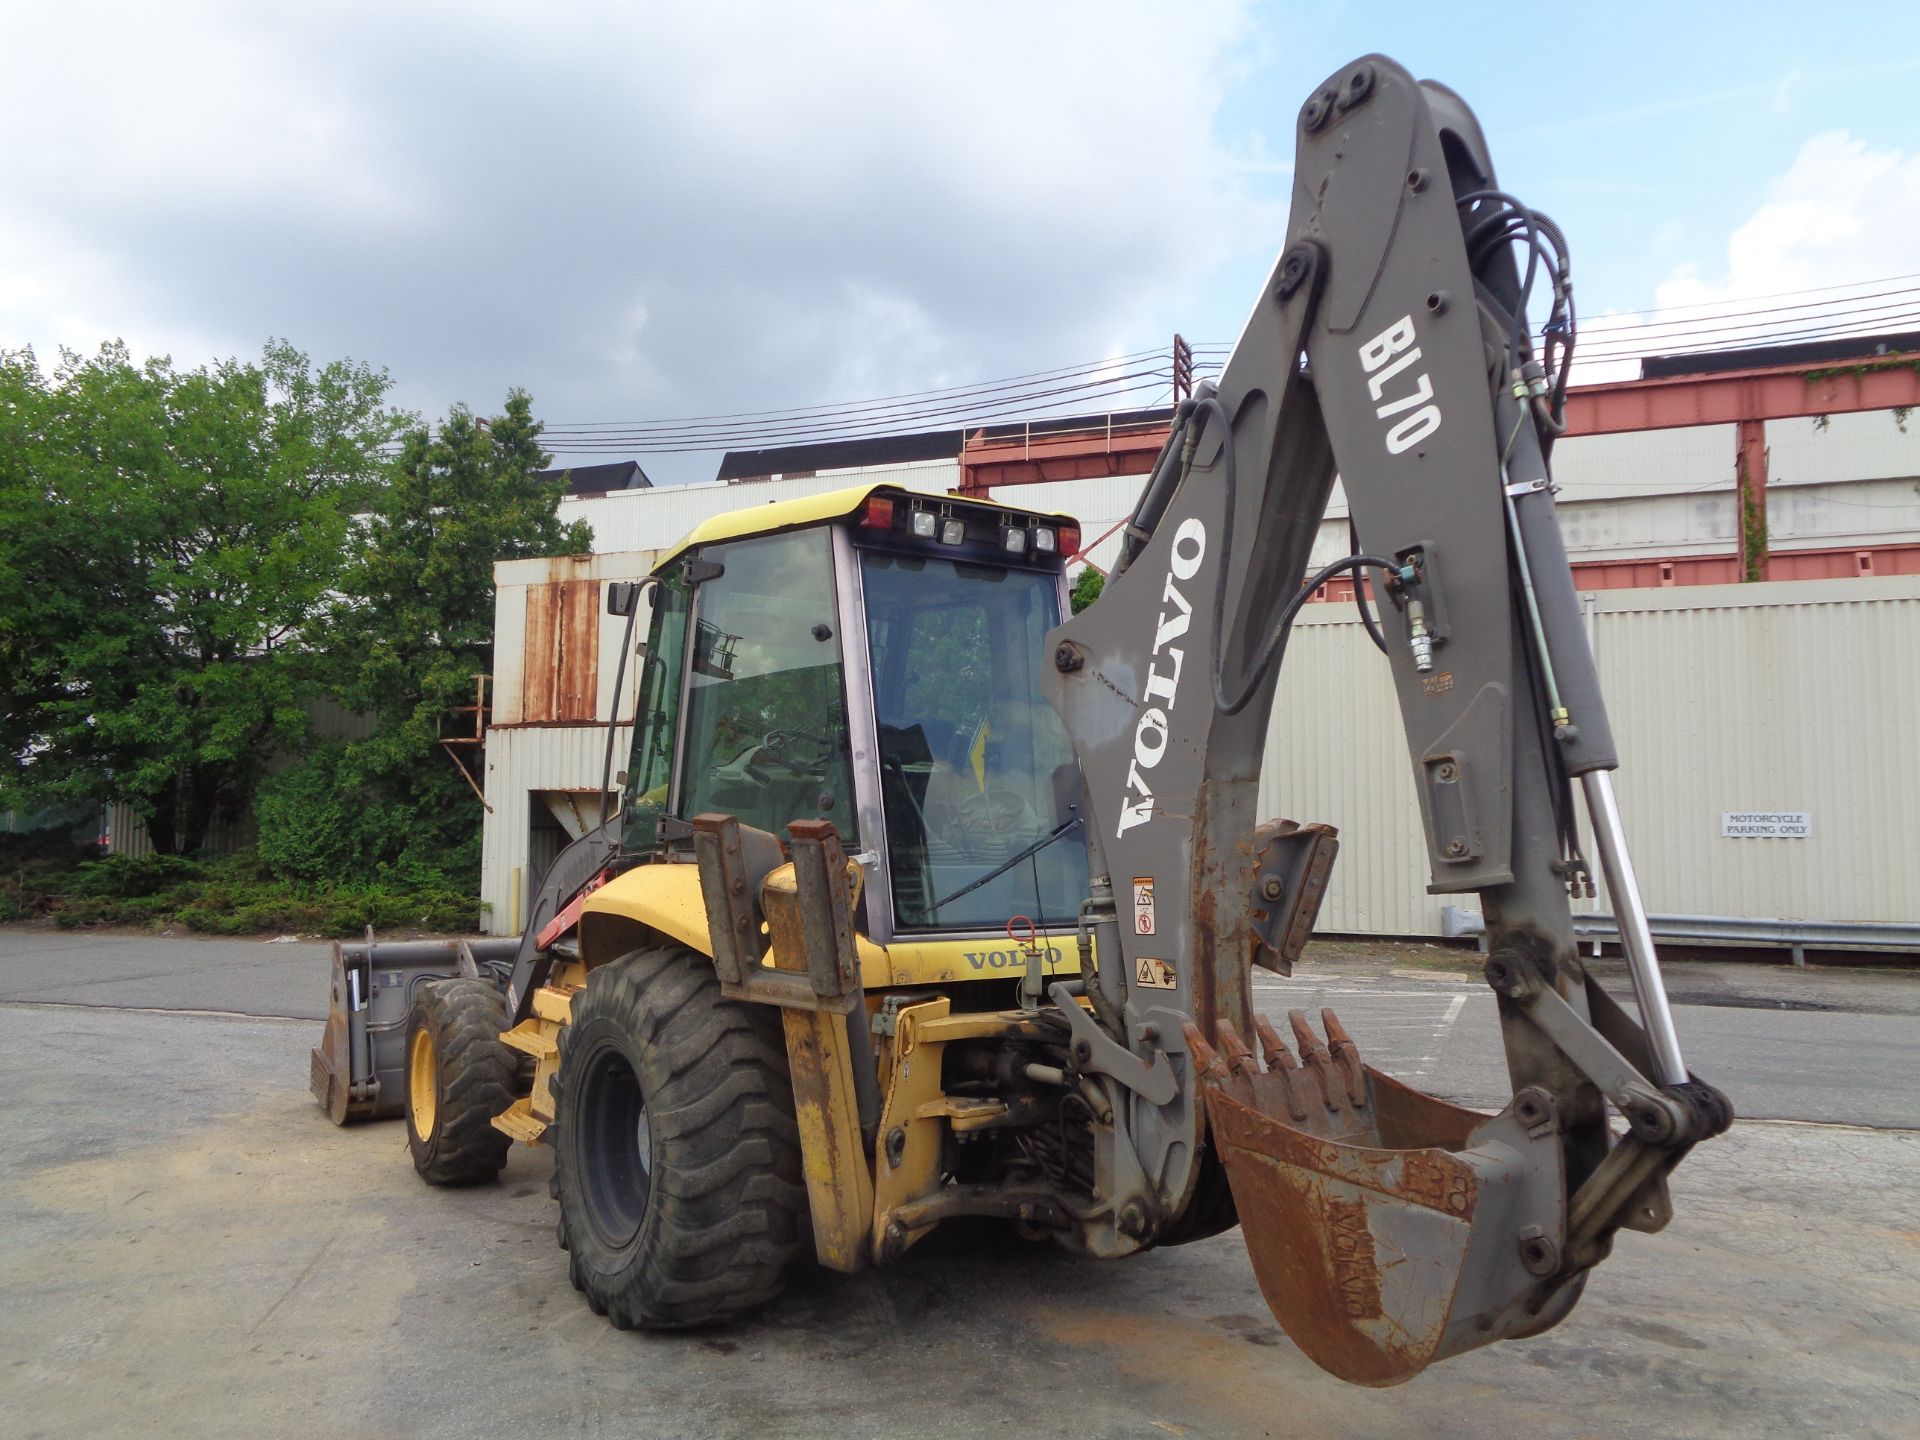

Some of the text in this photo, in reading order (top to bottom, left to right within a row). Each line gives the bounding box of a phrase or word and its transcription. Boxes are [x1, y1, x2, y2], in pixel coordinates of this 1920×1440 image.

[1358, 314, 1442, 455] BL70
[1116, 517, 1207, 840] VOLVO
[1727, 825, 1808, 834] PARKING ONLY
[1729, 814, 1803, 823] MOTORCYCLE
